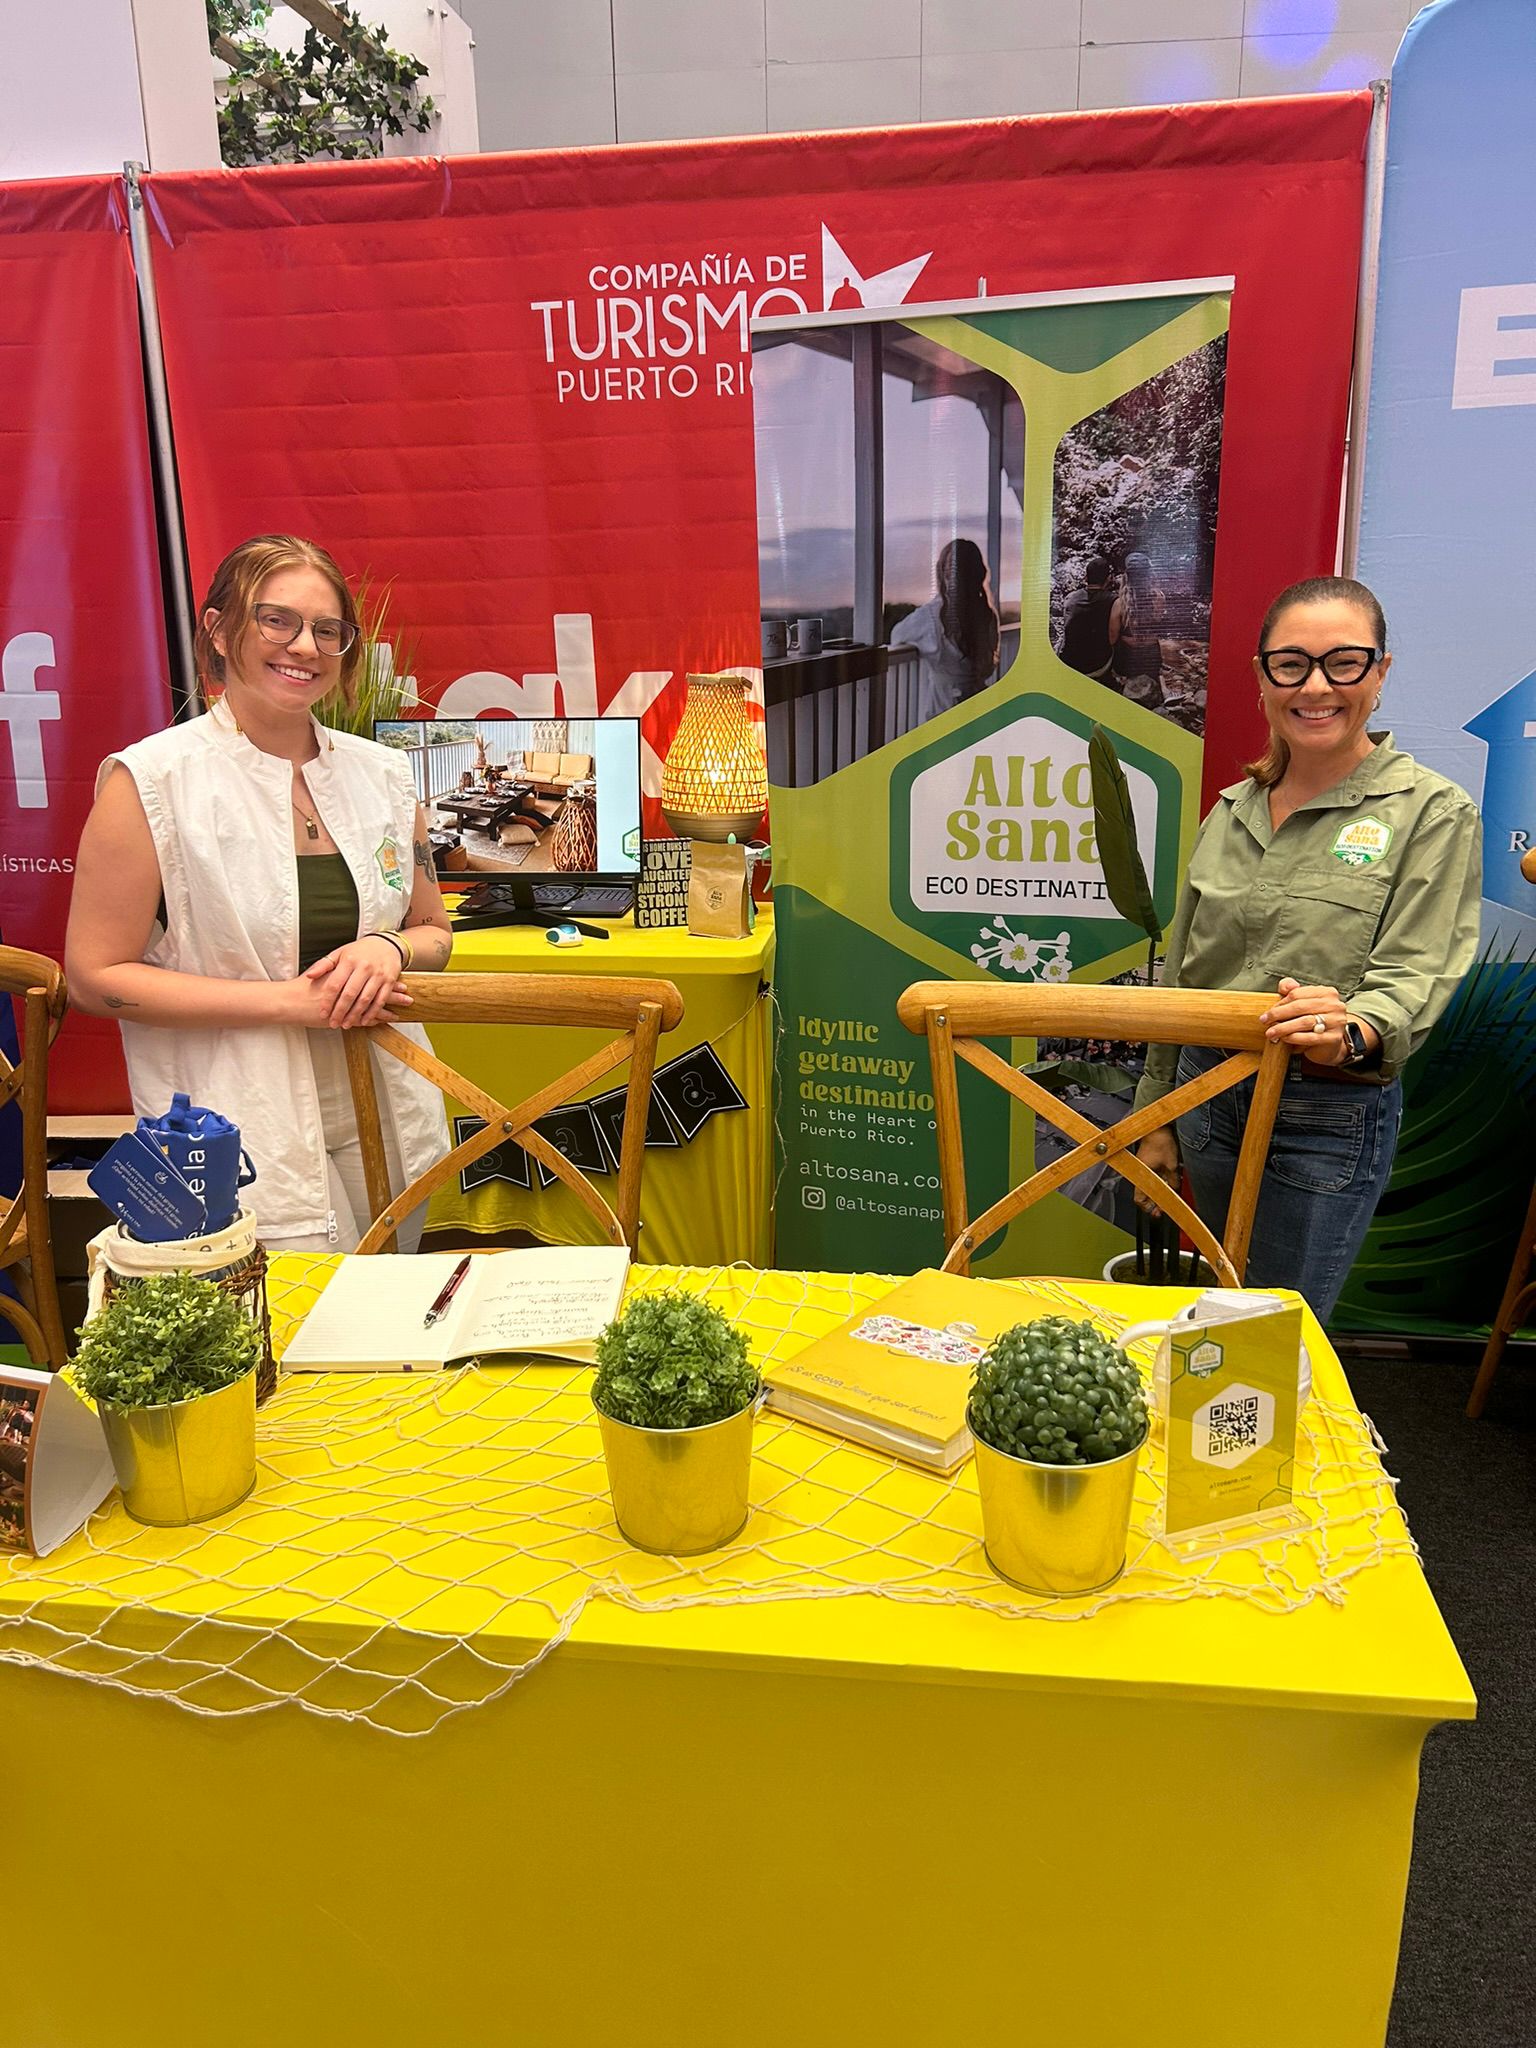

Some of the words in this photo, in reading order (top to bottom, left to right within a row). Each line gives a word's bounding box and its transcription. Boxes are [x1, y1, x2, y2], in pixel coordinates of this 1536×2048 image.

[588, 253, 755, 291] COMPAÑÍA
[766, 254, 807, 282] DE
[557, 364, 699, 402] PUERTO
[715, 361, 754, 396] RI
[963, 755, 1094, 809] Alto
[945, 809, 1103, 864] Sana
[0, 854, 74, 873] ÍSTICAS
[643, 851, 692, 870] OVE
[638, 883, 656, 894] AND
[657, 881, 681, 893] CUPS
[926, 876, 968, 895] ECO
[976, 877, 1111, 900] DESTINATI
[638, 907, 689, 927] COFFE
[799, 1015, 880, 1046] Idyllic
[798, 1051, 915, 1085] getaway
[799, 1080, 935, 1112] destinatio
[800, 1104, 818, 1118] in
[828, 1109, 856, 1122] the
[867, 1112, 917, 1128] Heart
[800, 1122, 857, 1140] Puerto
[867, 1130, 915, 1146] Rico.
[182, 1149, 206, 1170] la
[800, 1159, 943, 1190] altosana.co
